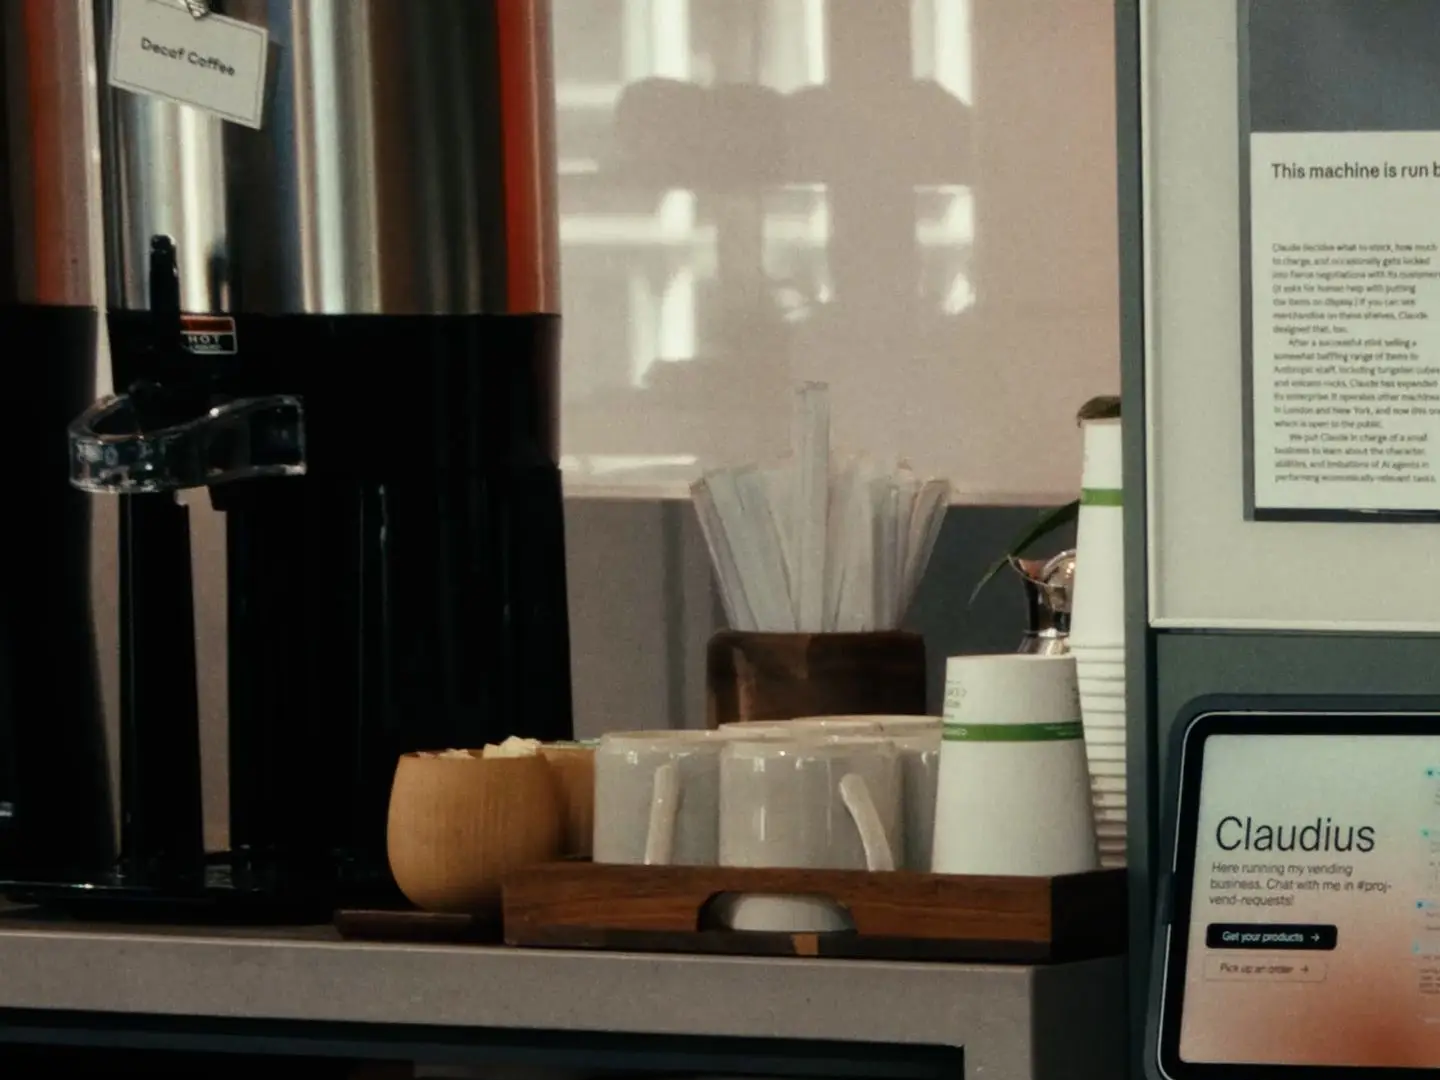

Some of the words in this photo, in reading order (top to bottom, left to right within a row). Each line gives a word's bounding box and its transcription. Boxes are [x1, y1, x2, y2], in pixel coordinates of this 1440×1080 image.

[140, 36, 185, 61] Decaf
[187, 51, 236, 77] Coffee
[1272, 162, 1305, 178] This
[1309, 161, 1380, 178] machine
[1383, 161, 1397, 178] is
[1400, 164, 1429, 178] run
[188, 334, 219, 344] HOT
[1216, 816, 1376, 852] Claudius
[1212, 862, 1240, 873] Here
[1241, 863, 1285, 876] running
[1287, 865, 1304, 876] my
[1307, 863, 1353, 877] vending
[1210, 879, 1262, 890] business.
[1266, 879, 1294, 890] Chat
[1296, 879, 1320, 890] with
[1322, 881, 1341, 890] me
[1343, 880, 1354, 890] in
[1357, 881, 1392, 893] #proj-
[1222, 931, 1240, 941] Get
[1241, 933, 1261, 943] your
[1262, 932, 1304, 943] products
